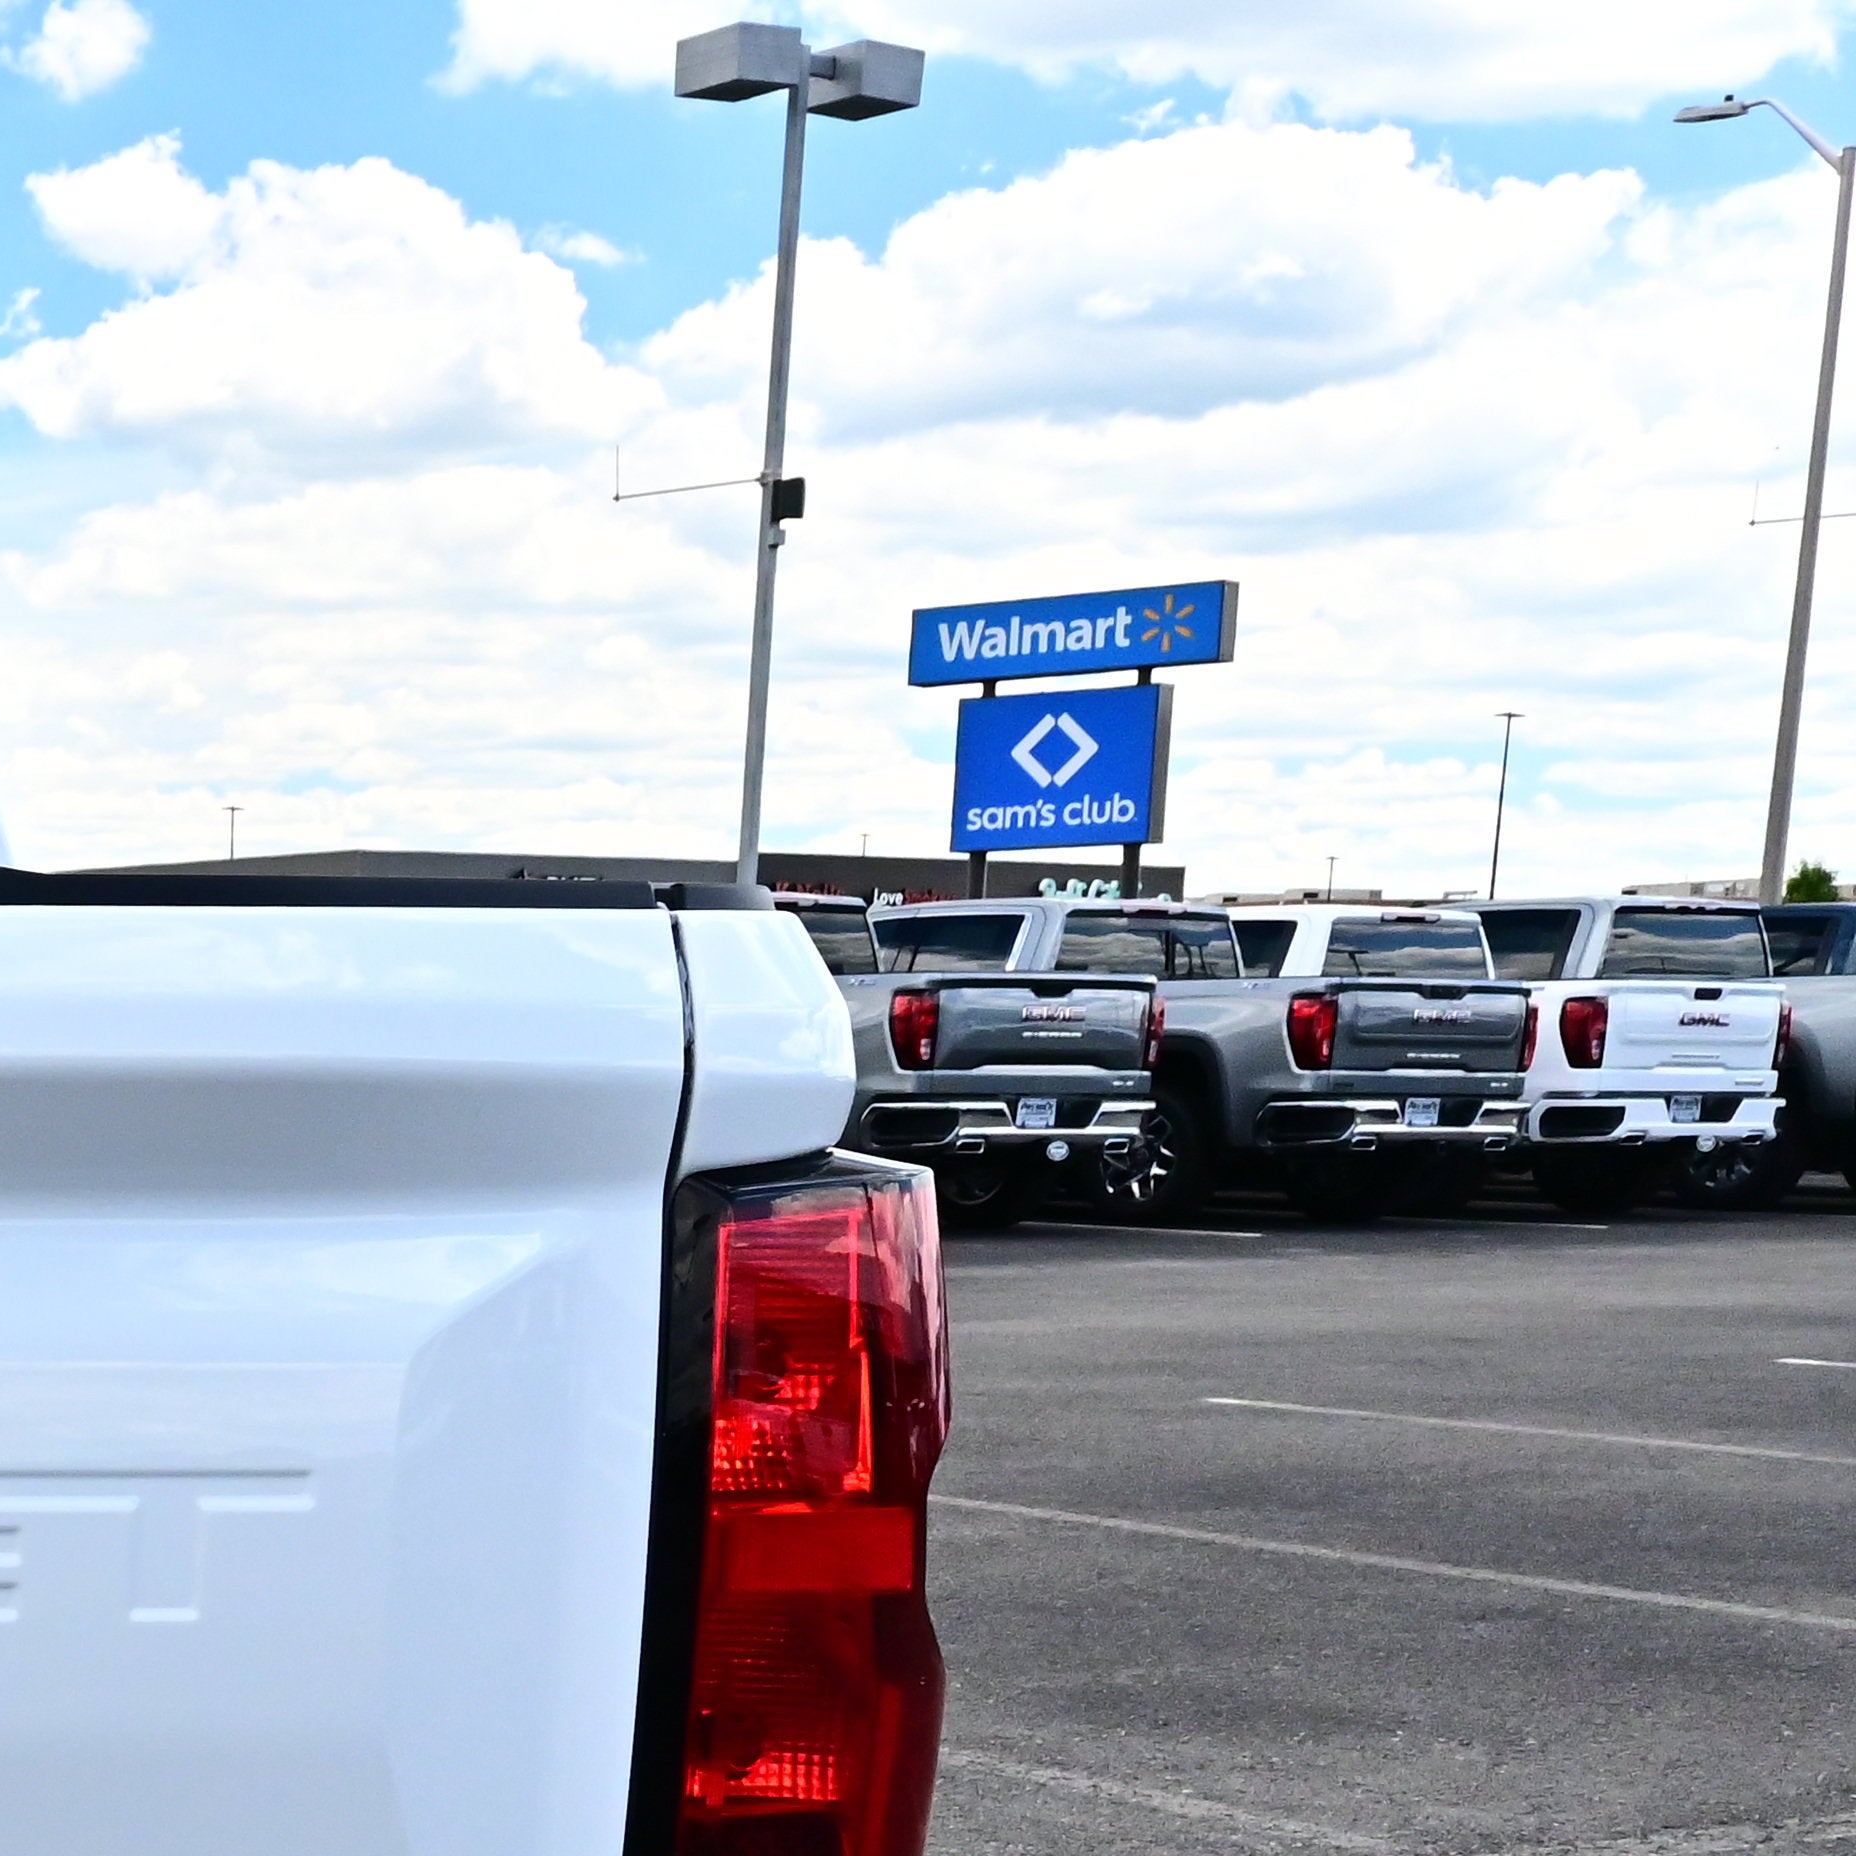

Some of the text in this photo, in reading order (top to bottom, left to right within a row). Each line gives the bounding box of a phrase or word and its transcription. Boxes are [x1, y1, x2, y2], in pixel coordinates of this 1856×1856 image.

[939, 606, 1131, 662] Walmart
[966, 793, 1135, 831] sam's club
[1678, 1012, 1731, 1026] GMC
